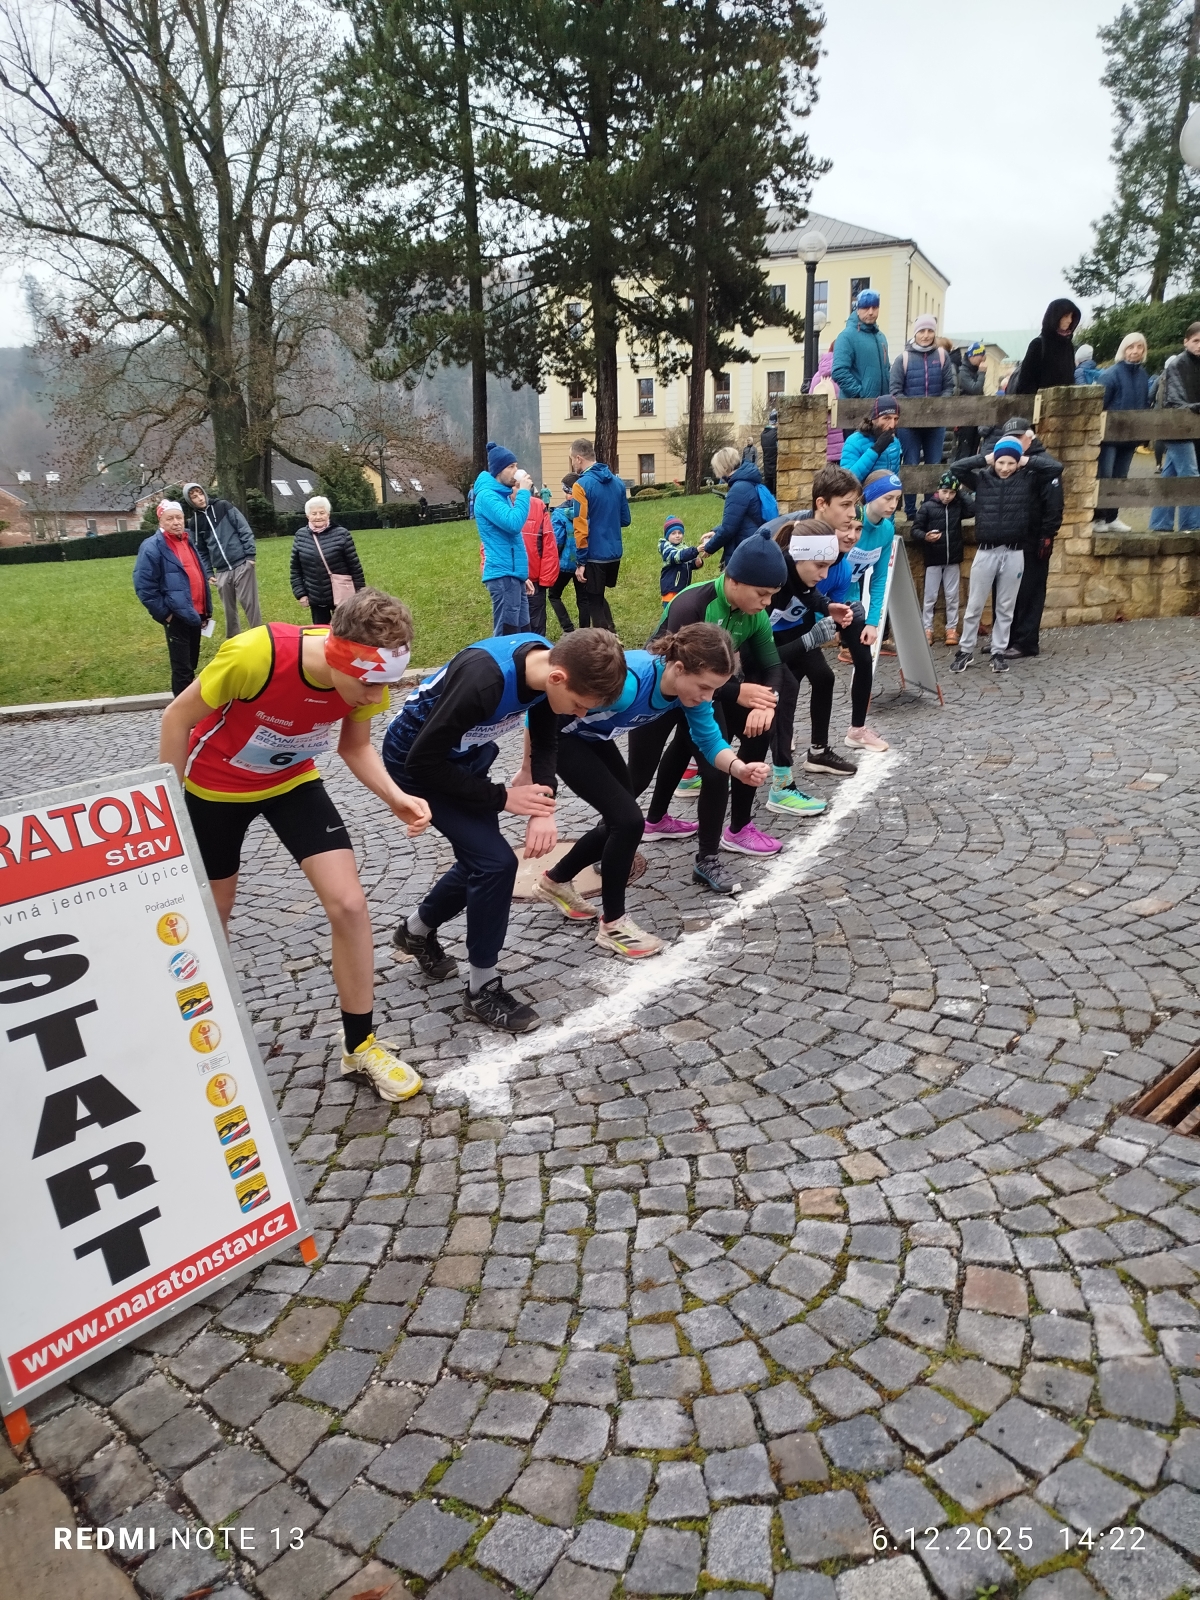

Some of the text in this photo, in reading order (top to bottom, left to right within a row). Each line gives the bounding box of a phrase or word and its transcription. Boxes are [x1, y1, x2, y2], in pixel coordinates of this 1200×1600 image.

[790, 606, 805, 617] 6
[259, 728, 296, 744] ZIMNÍ
[308, 740, 329, 748] LIGA
[269, 752, 297, 766] 6
[105, 835, 172, 867] stav
[51, 880, 129, 914] jednota
[138, 863, 189, 886] Úpice
[144, 894, 186, 914] Pořadatel
[0, 933, 161, 1286] START
[21, 1212, 289, 1373] www.maratonstav.cz
